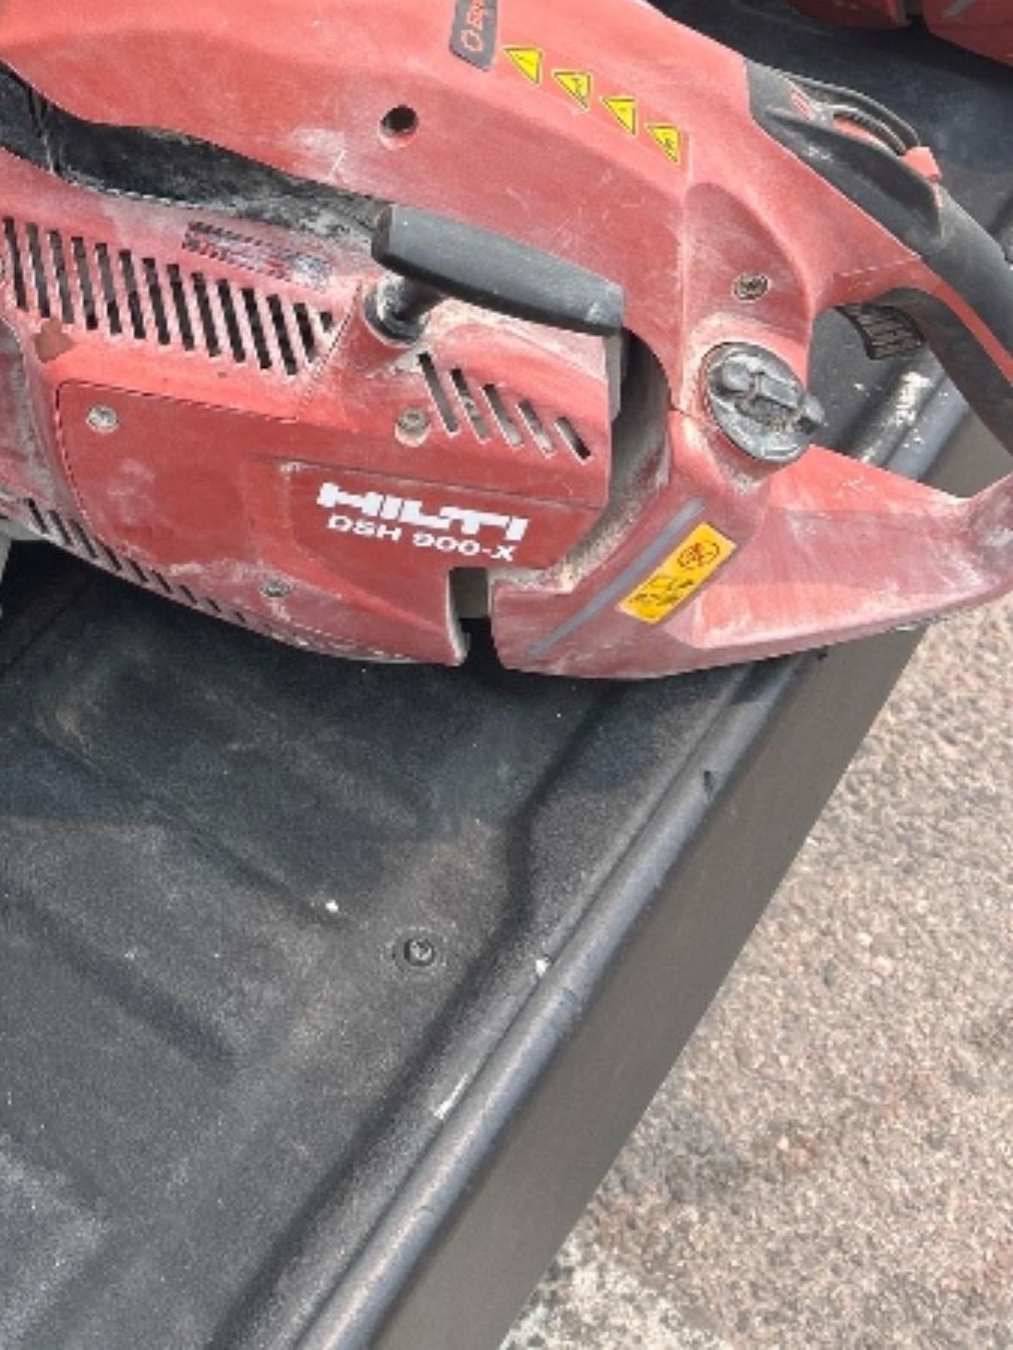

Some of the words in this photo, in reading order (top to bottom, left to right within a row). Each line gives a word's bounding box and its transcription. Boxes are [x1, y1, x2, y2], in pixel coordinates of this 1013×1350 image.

[316, 481, 530, 542] HILTI
[327, 513, 402, 542] DSH
[412, 532, 517, 562] 900-X
